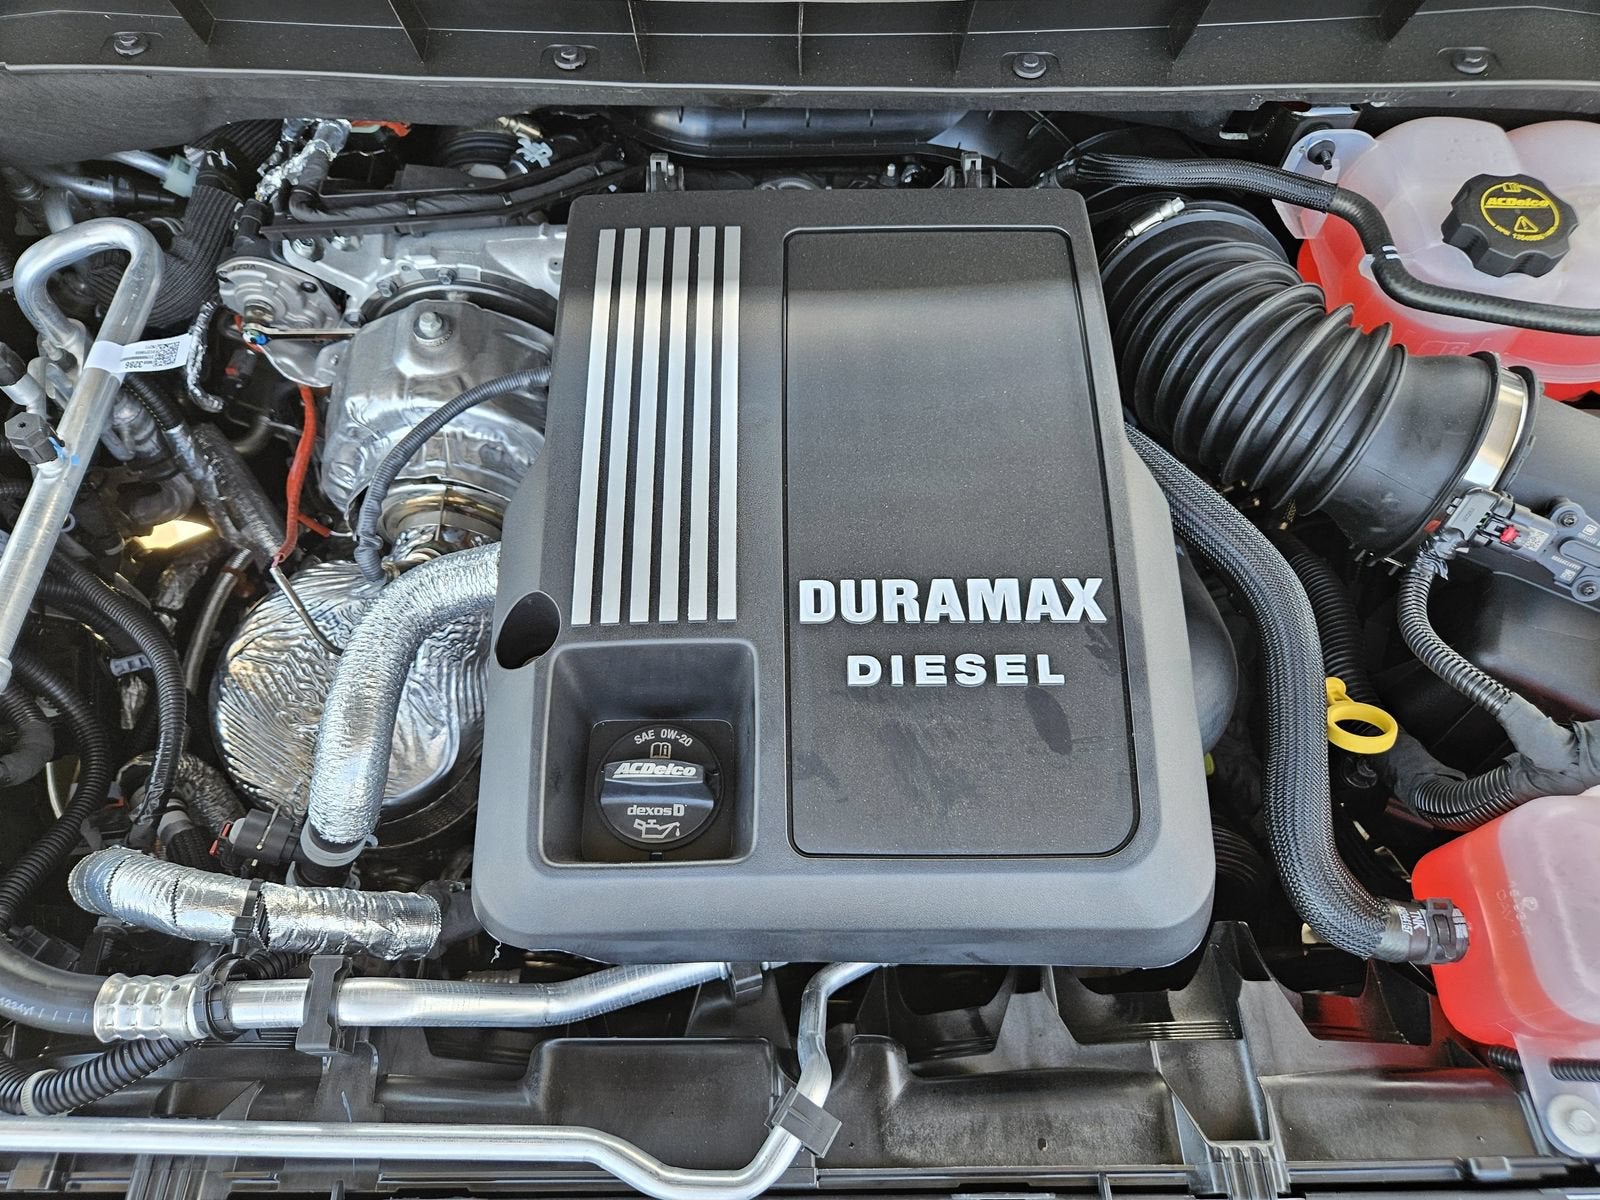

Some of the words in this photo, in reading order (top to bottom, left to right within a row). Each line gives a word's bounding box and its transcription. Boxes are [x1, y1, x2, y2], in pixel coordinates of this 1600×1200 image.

[799, 578, 1107, 624] DURAMAX
[847, 653, 1065, 687] DIESEL
[634, 729, 656, 745] SAE
[660, 728, 693, 747] 0W-20
[613, 762, 697, 777] ACDelco
[1409, 910, 1426, 930] TNK
